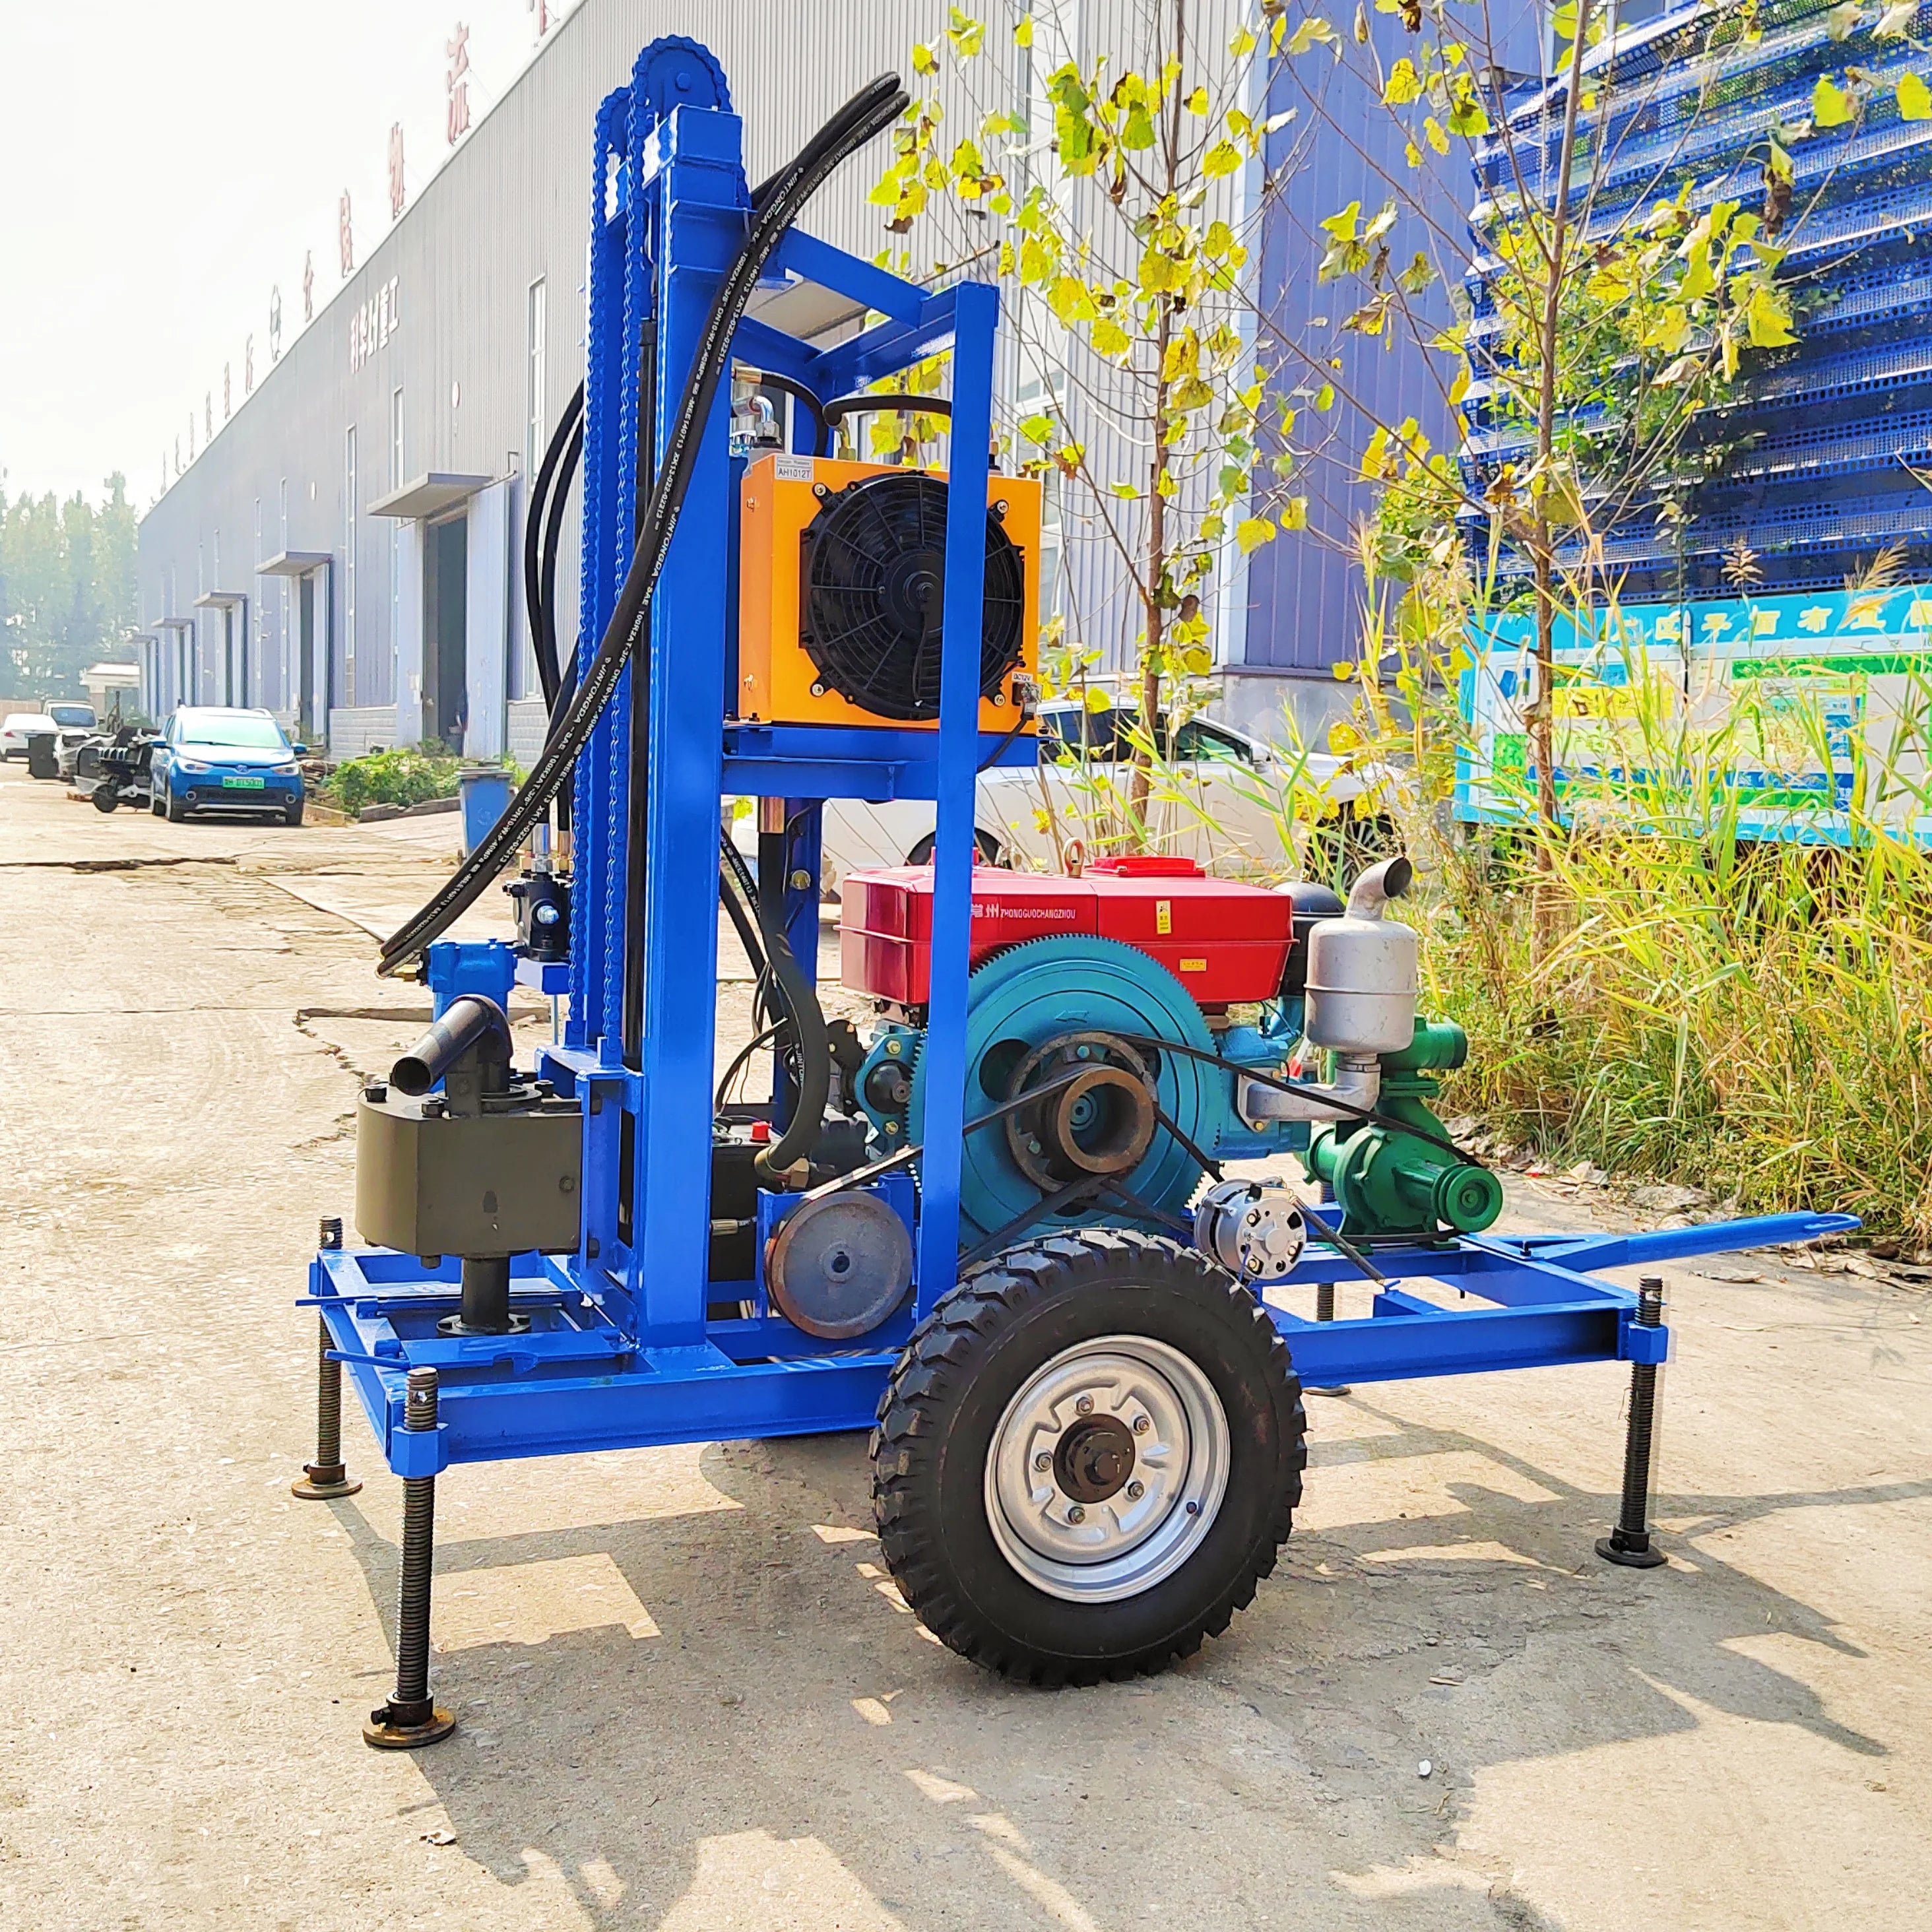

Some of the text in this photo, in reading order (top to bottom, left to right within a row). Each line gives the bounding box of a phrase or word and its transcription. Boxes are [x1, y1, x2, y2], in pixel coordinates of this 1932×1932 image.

[761, 172, 798, 224] JINTONGDA
[779, 468, 811, 478] AH1012T
[651, 513, 677, 577] JINTONGDA
[573, 664, 607, 724] JINTONGDA
